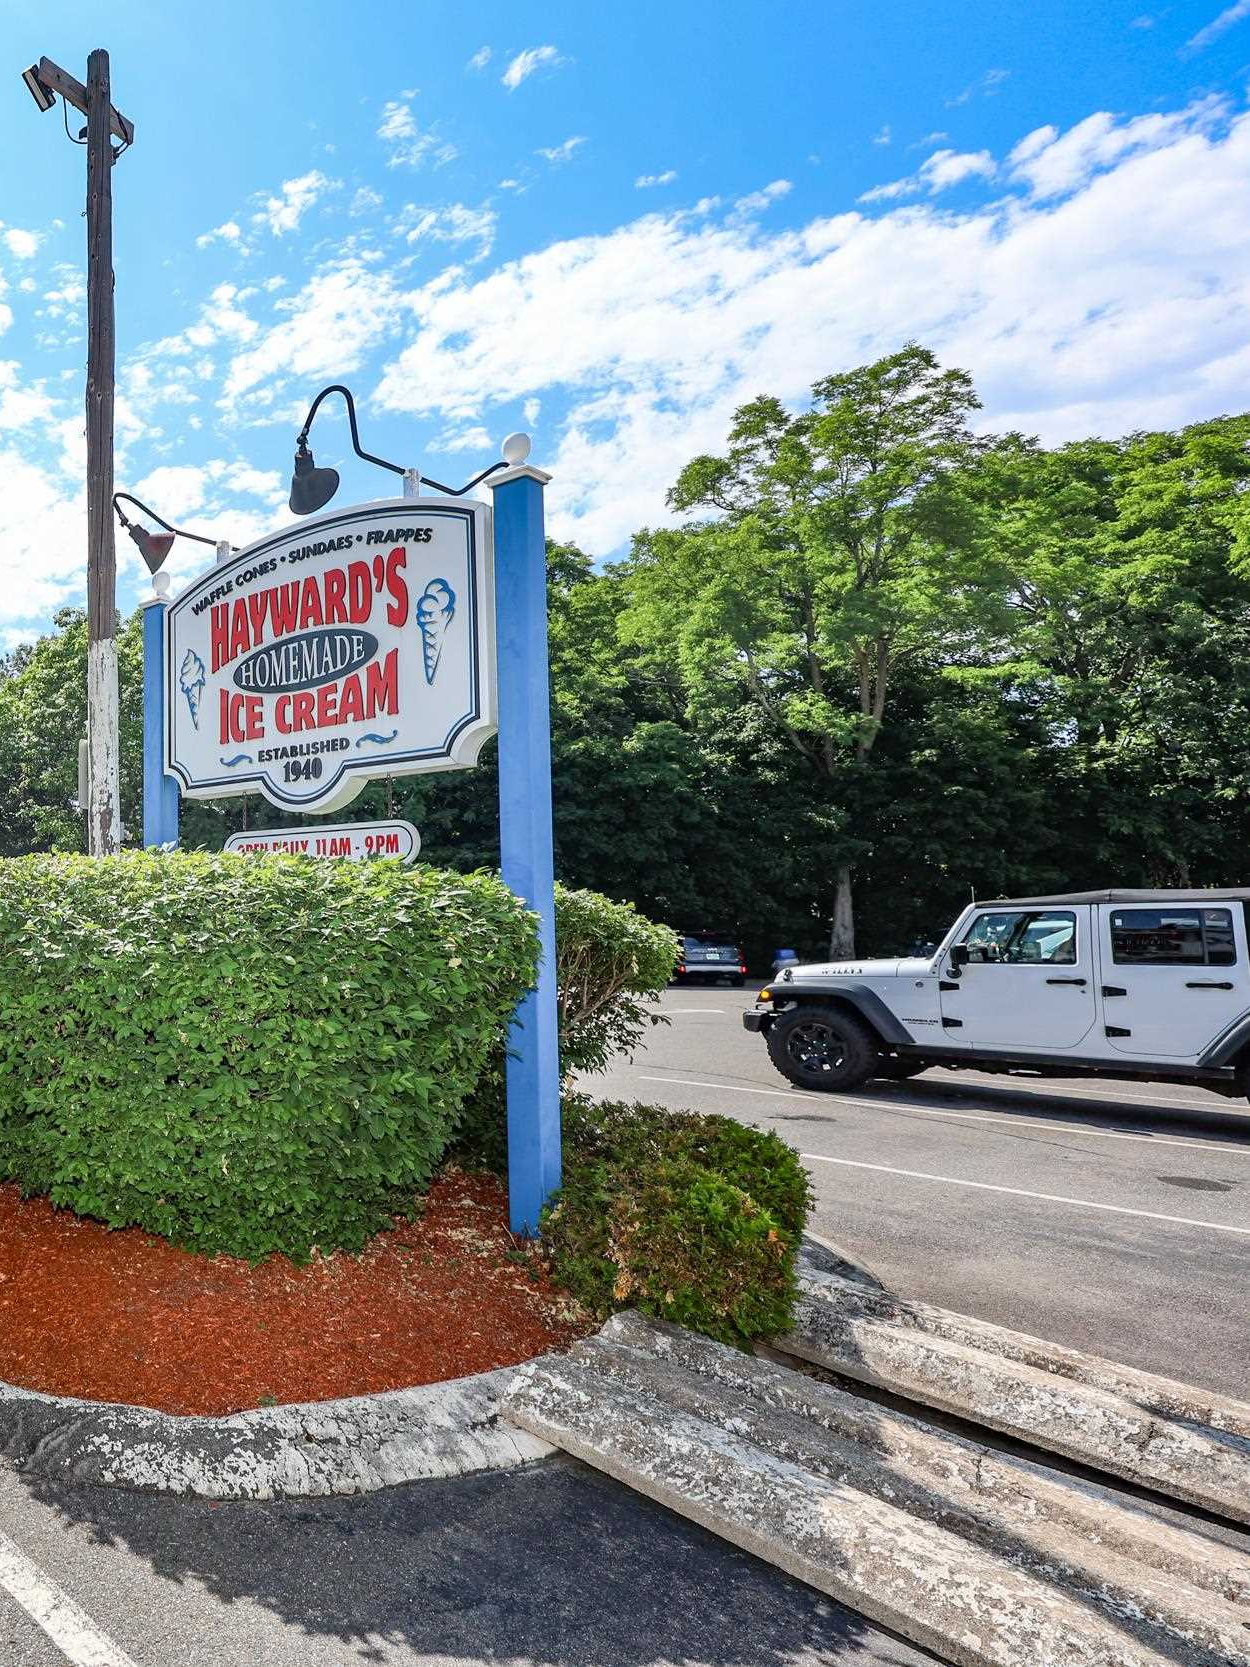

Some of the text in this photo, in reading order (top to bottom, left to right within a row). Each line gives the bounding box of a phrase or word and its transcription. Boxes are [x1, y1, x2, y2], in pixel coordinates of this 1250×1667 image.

[191, 527, 433, 616] WAFFLE CONES SUNDAES FRAPPES
[210, 546, 409, 674] HAYWARD'S
[219, 648, 399, 745] ICE CREAM
[240, 635, 365, 688] HOMEMADE
[258, 737, 350, 762] ESTABLISHED
[283, 757, 323, 783] 1940
